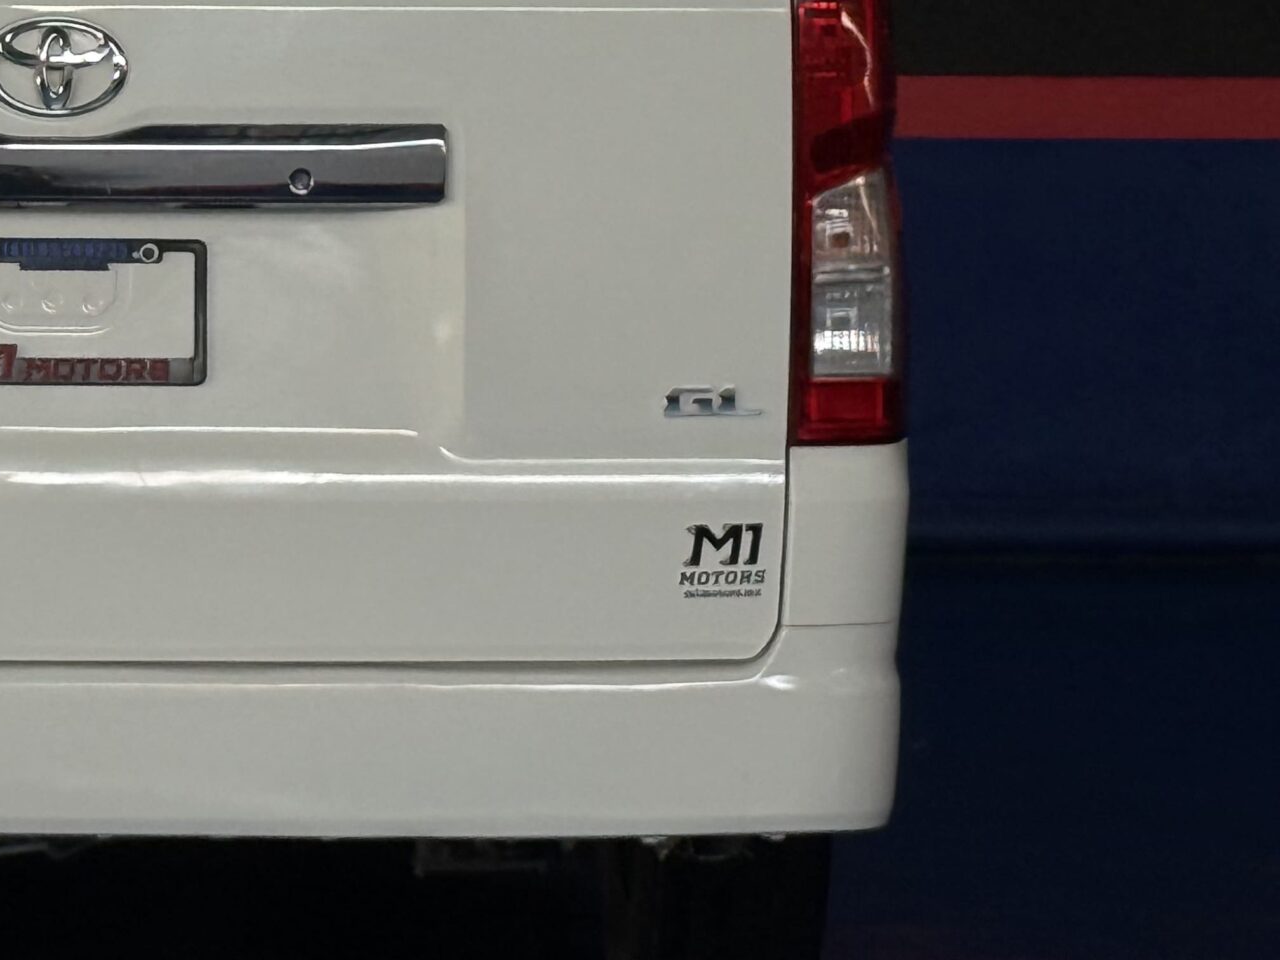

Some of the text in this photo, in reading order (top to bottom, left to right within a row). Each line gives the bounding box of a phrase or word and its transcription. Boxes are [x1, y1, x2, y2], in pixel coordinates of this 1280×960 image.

[23, 358, 169, 381] MOTORS
[663, 385, 763, 417] GL
[683, 522, 764, 567] M1
[679, 569, 766, 586] MOTORS
